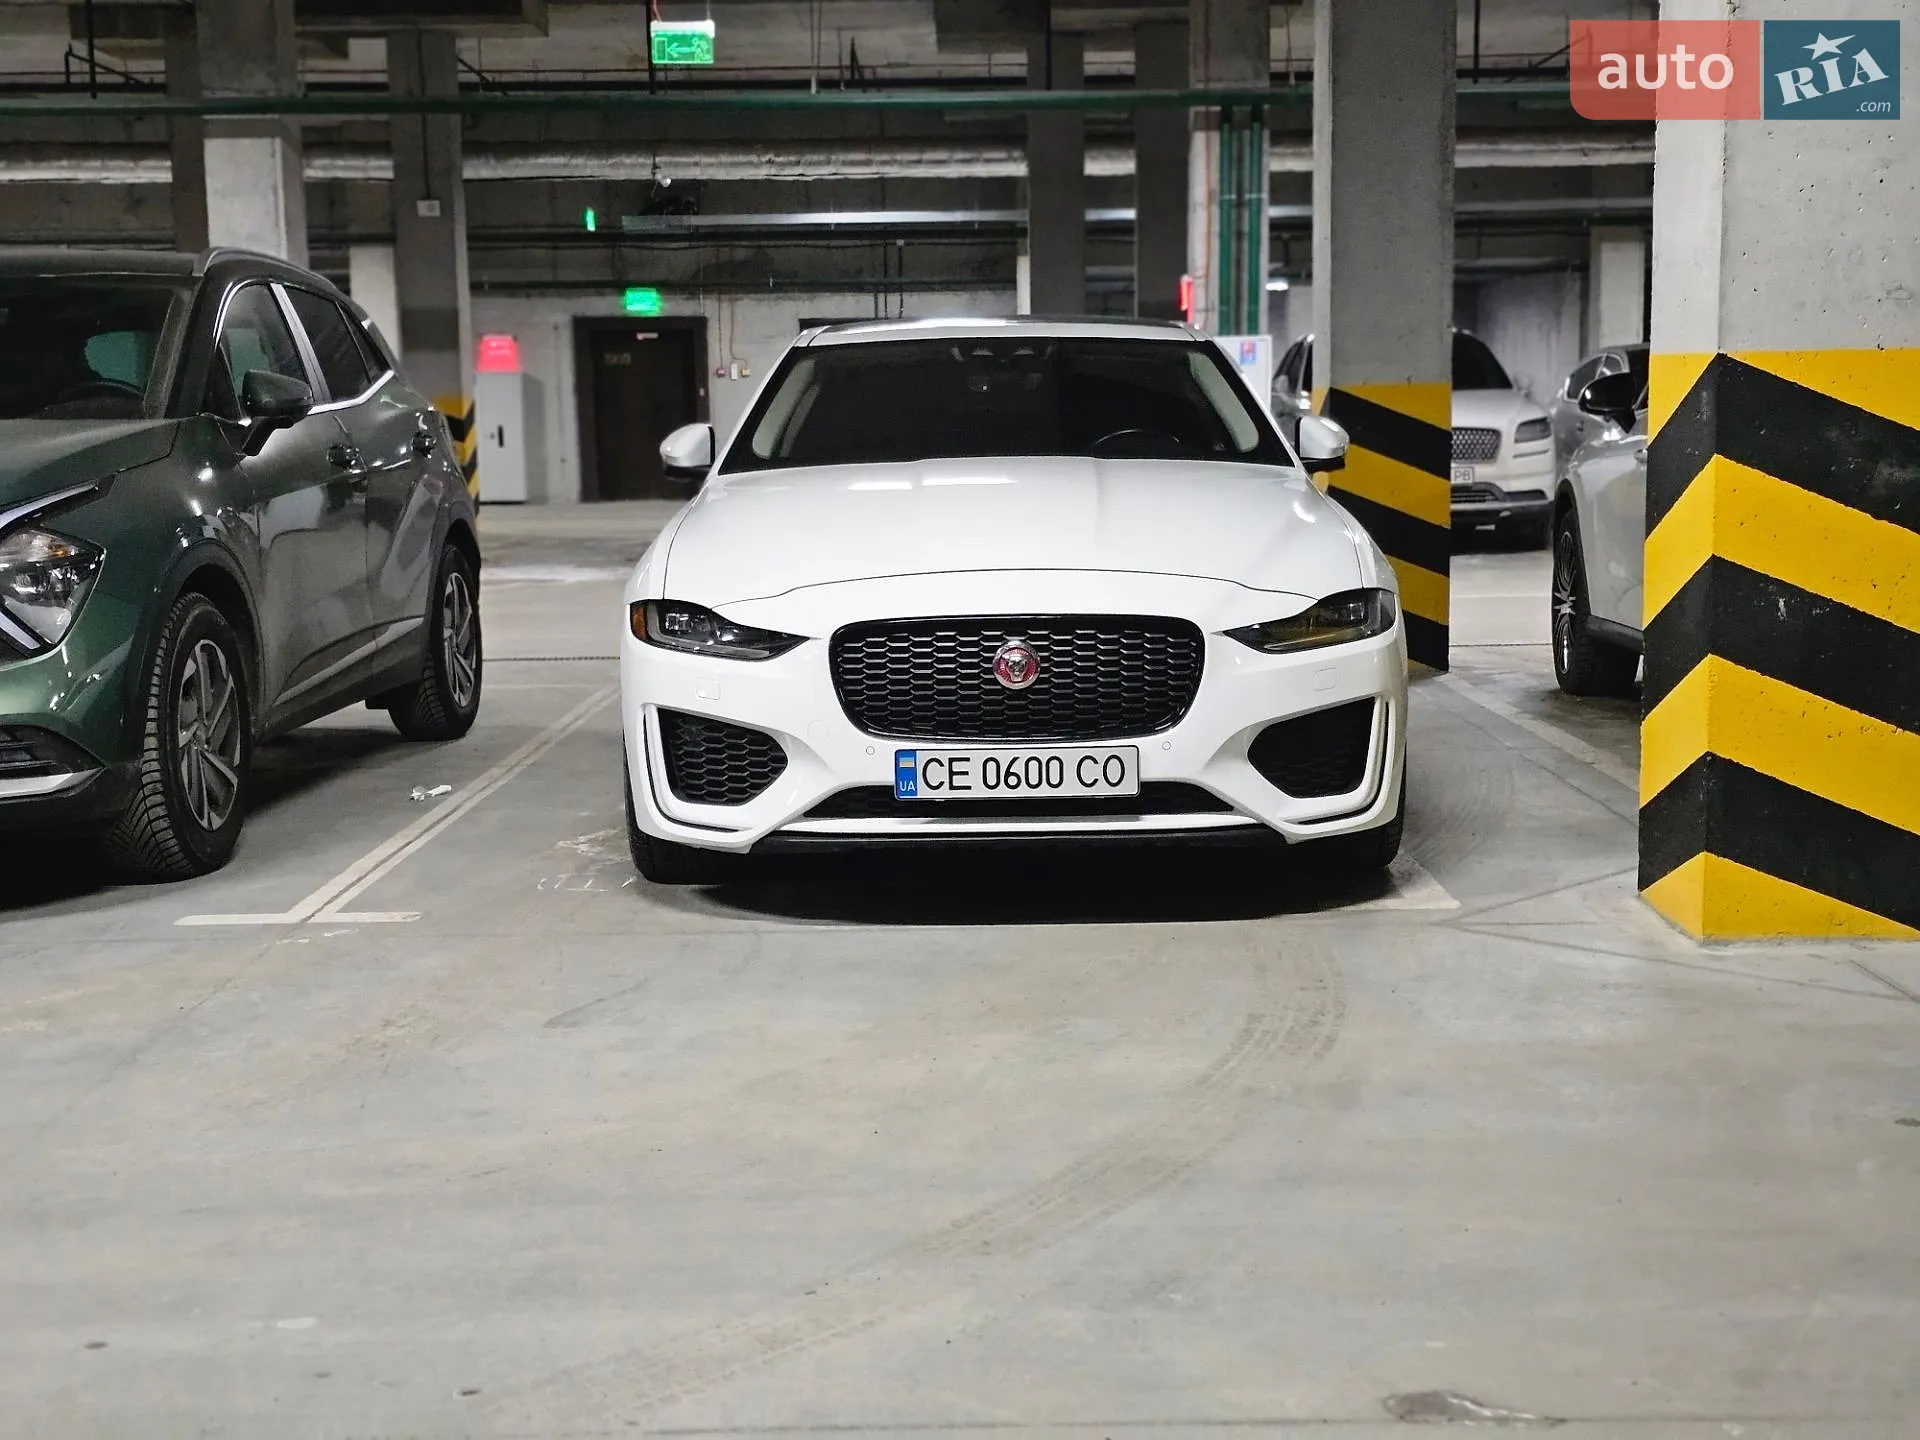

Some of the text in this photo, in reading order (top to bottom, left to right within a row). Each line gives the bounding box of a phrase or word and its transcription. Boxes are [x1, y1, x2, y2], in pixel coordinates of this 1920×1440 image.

[922, 754, 1126, 791] CE 0600 CO
[900, 780, 916, 792] UA
